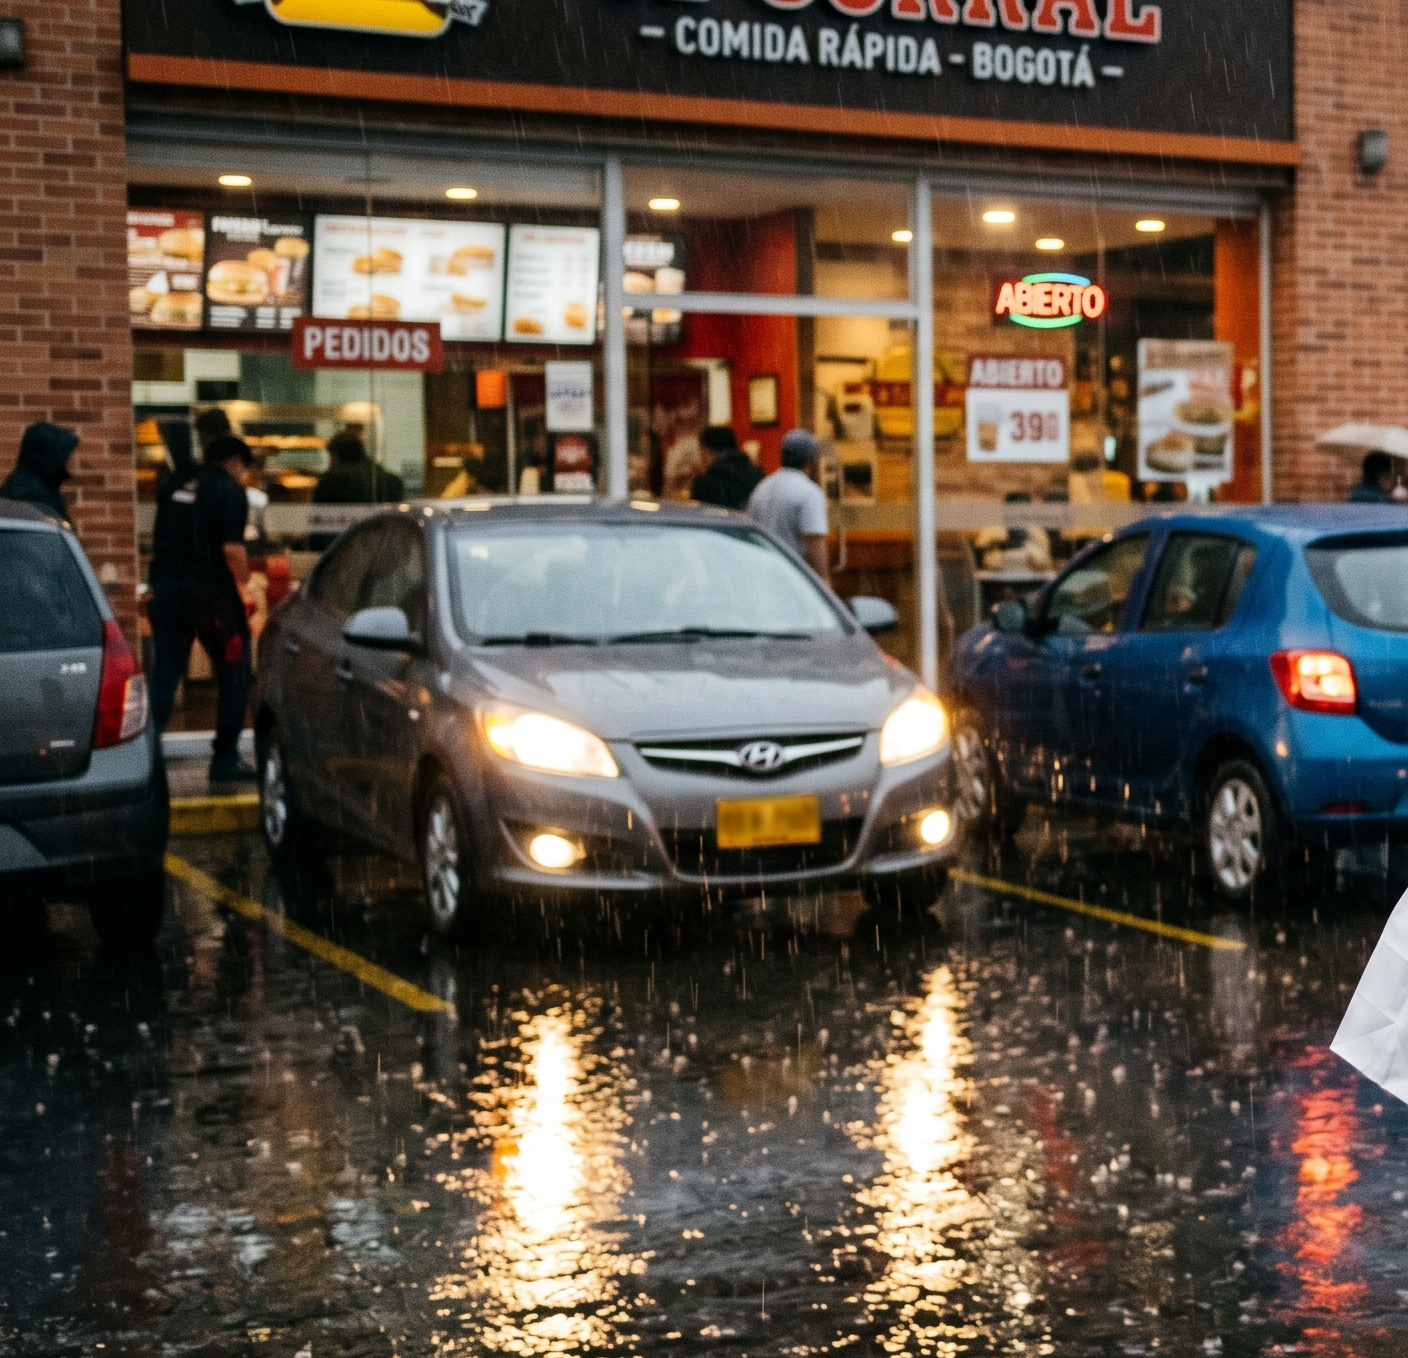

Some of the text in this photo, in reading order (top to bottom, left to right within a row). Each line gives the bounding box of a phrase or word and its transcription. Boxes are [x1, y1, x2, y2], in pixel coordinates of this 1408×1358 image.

[675, 15, 809, 64] COMIDA
[818, 22, 942, 76] RÁPIDA
[972, 42, 1095, 88] BOGOTÁ
[303, 325, 430, 363] PEDIDOS
